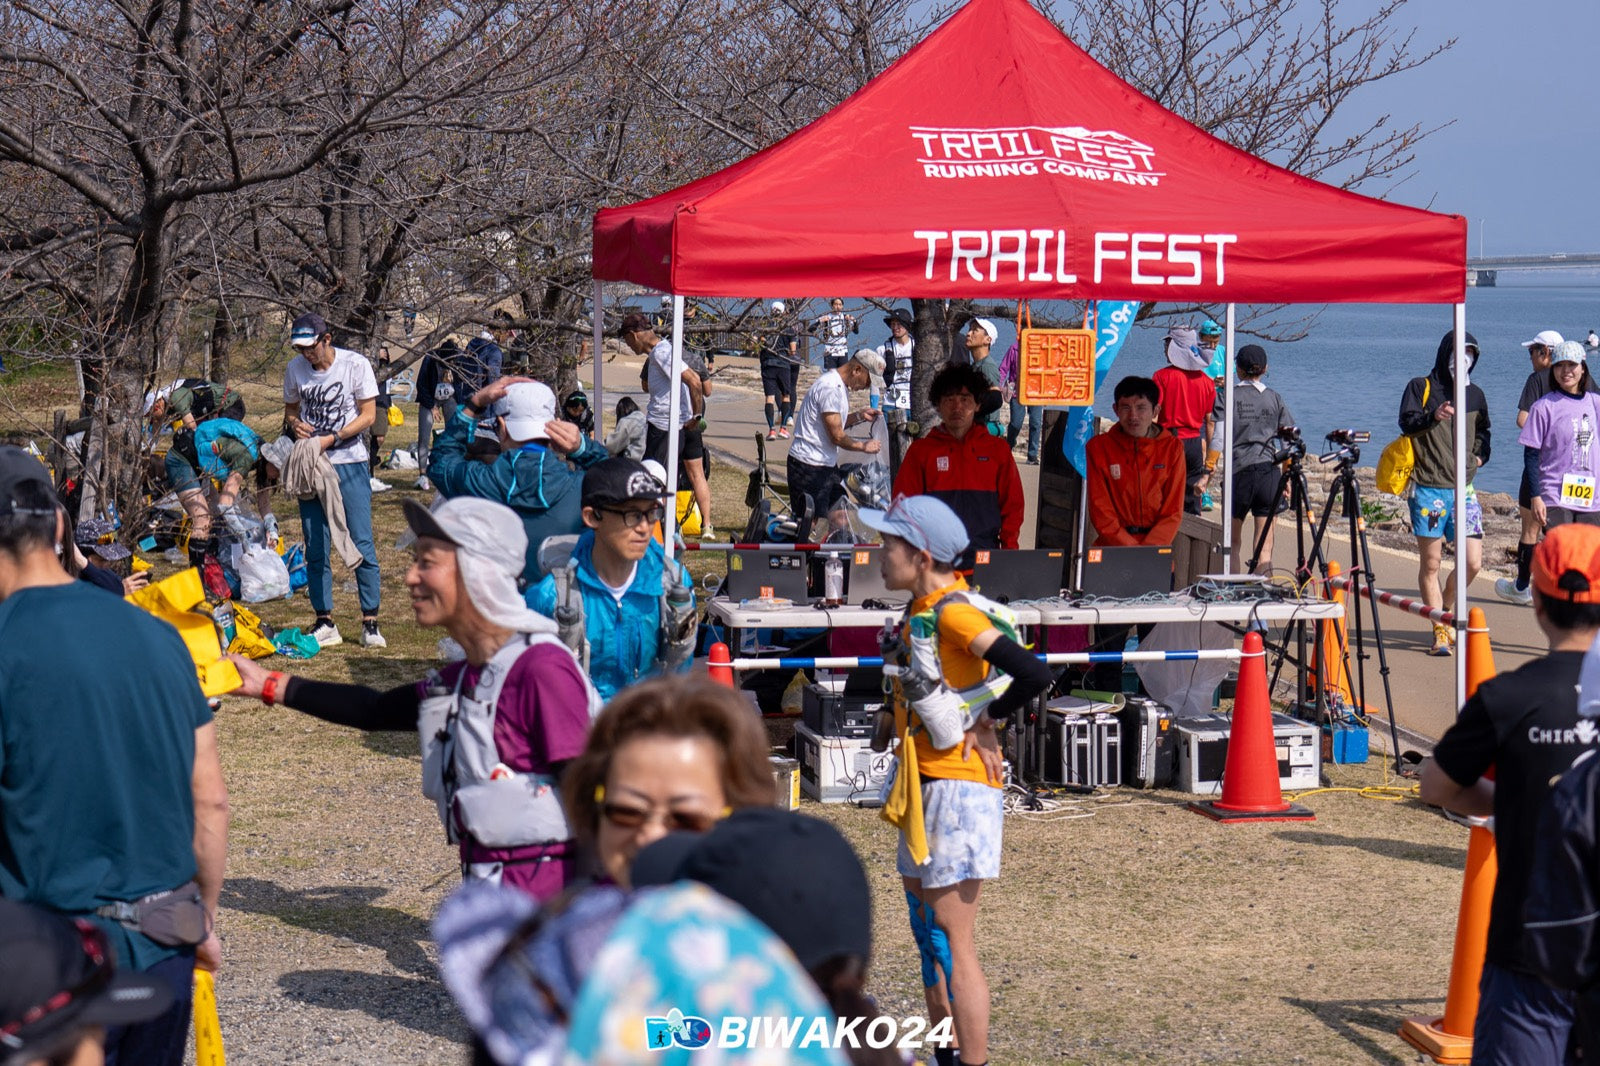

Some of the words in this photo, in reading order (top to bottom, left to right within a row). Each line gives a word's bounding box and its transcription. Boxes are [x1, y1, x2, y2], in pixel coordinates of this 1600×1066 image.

[911, 132, 1043, 158] TRAIL
[1052, 135, 1156, 171] FEST
[924, 161, 1039, 179] RUNNING
[1042, 161, 1161, 187] COMPANY
[913, 229, 1077, 284] TRAIL
[1094, 232, 1238, 286] FEST
[1027, 334, 1088, 367] 計測
[1026, 369, 1088, 398] 工房
[1568, 484, 1591, 499] 102
